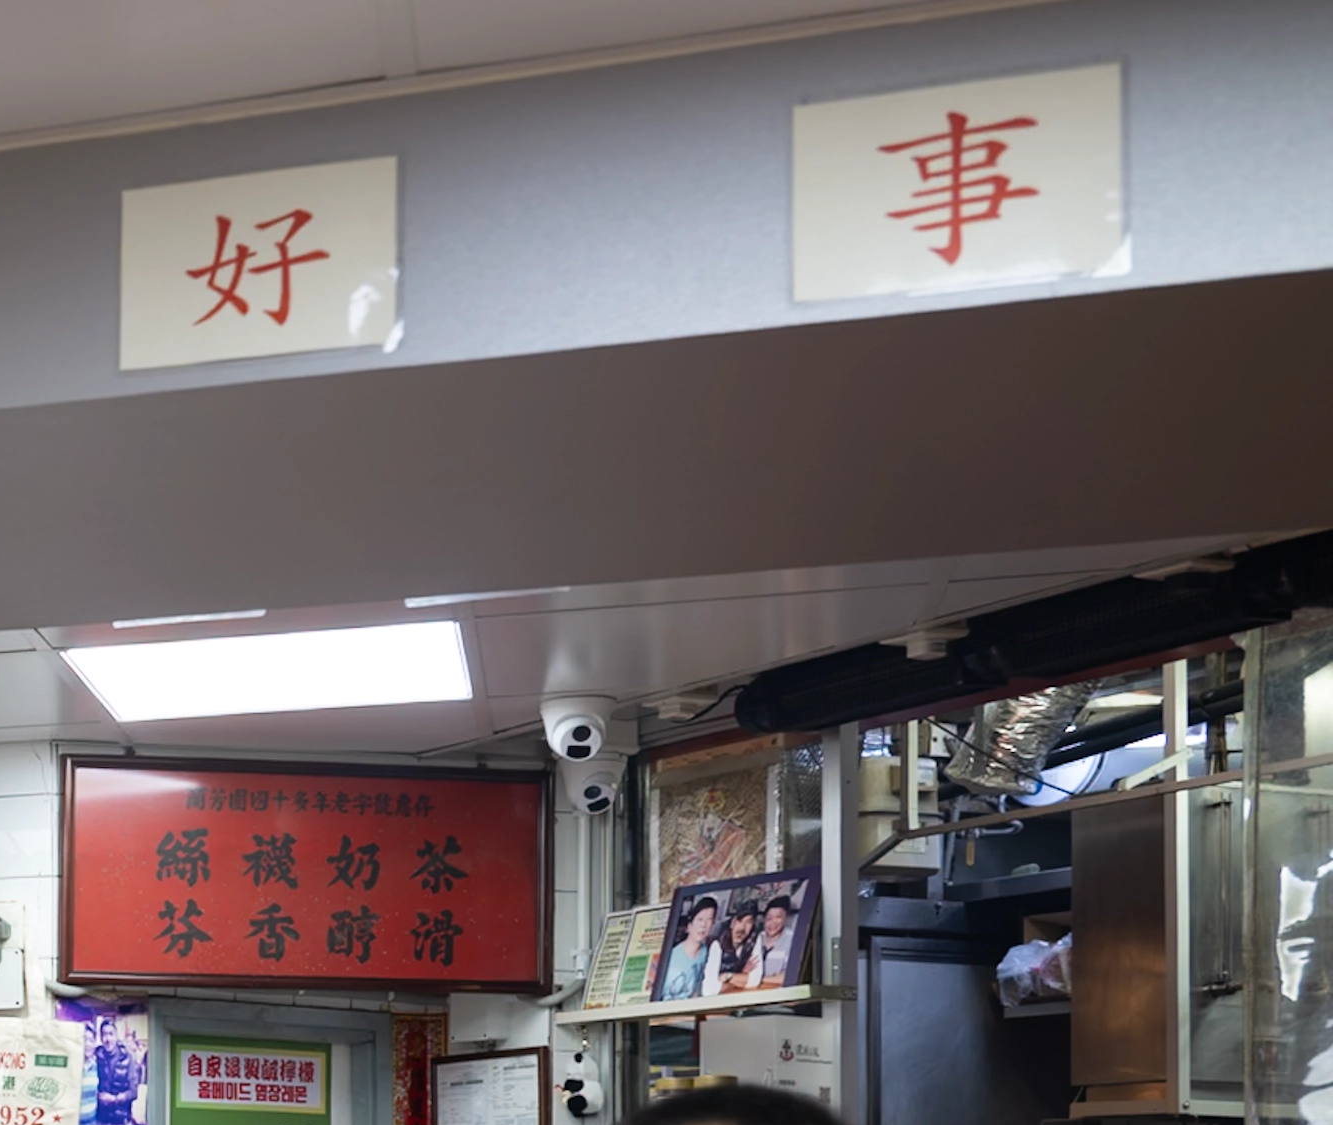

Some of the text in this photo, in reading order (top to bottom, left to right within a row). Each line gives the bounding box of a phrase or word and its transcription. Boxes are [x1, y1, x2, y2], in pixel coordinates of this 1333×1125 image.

[875, 111, 1041, 265] 事
[184, 207, 332, 327] 好
[154, 827, 469, 894] 絲襪奶茶
[153, 898, 464, 967] 芬香醇滑
